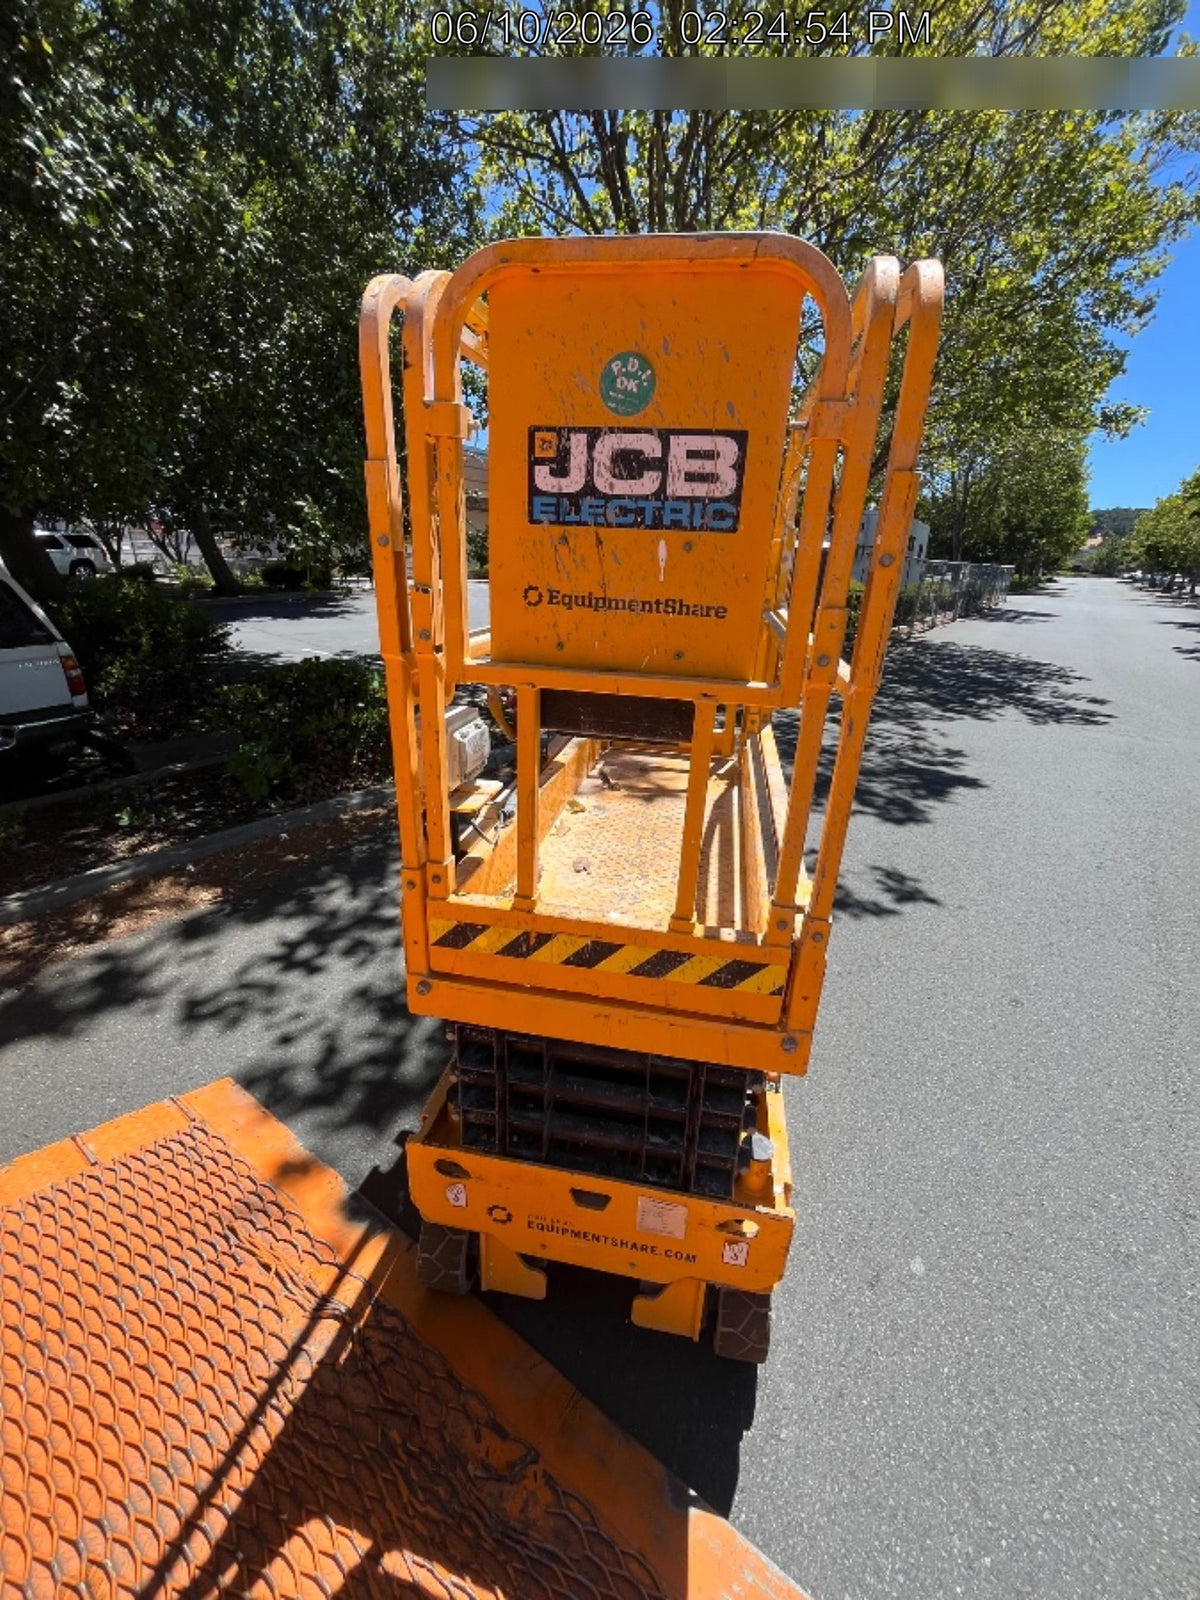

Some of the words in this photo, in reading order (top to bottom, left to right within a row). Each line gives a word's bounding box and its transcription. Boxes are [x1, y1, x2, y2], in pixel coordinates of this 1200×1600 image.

[616, 376, 640, 393] OK
[534, 433, 739, 497] JCB
[532, 496, 736, 528] ELECTRIC
[547, 588, 728, 619] EquipmentShare
[527, 1220, 697, 1263] EQUIPMENTSHARE.COM
